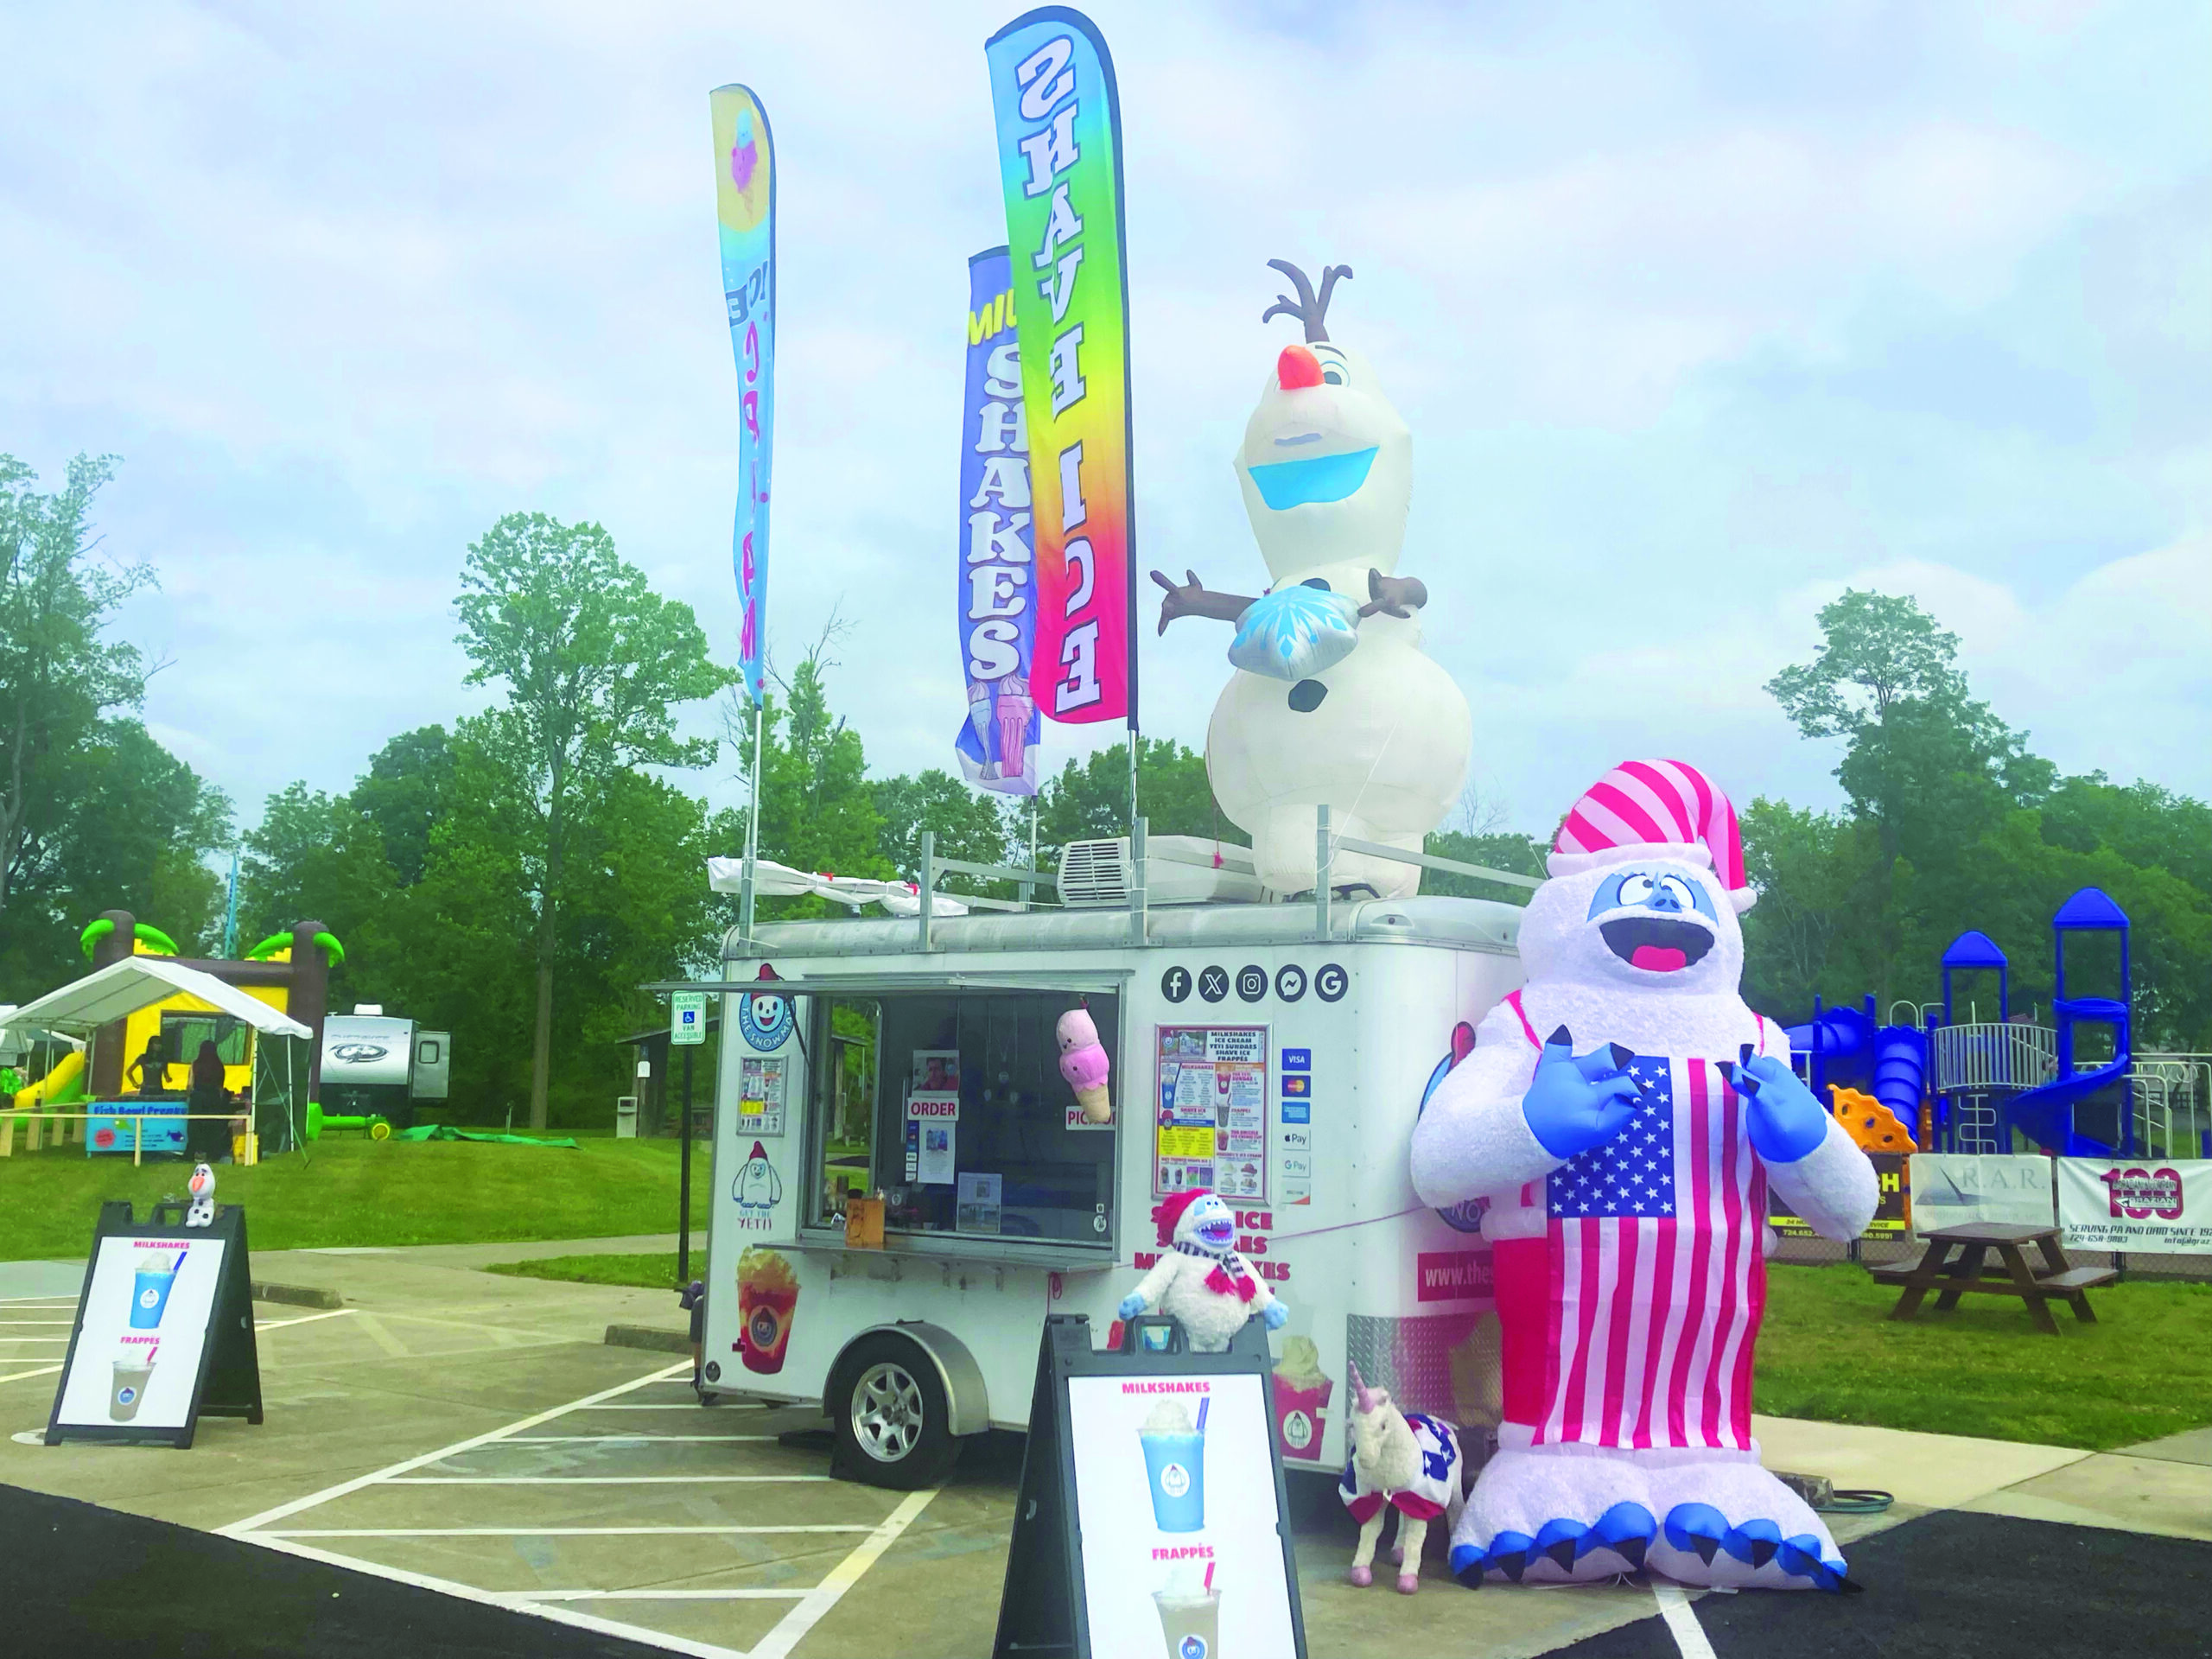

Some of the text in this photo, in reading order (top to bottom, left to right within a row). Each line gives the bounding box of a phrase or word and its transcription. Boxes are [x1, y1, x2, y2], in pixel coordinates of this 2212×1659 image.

[966, 342, 1032, 683] SHAKES
[742, 1007, 752, 1033] THE
[911, 1102, 956, 1116] ORDER
[1292, 1134, 1306, 1145] Pay
[1294, 1161, 1306, 1171] Pay
[1962, 1168, 2045, 1189] R.A.R.
[1236, 1211, 1273, 1230] ICE
[2069, 1224, 2107, 1234] SERVING
[2110, 1225, 2123, 1234] PA
[2126, 1225, 2144, 1235] AND
[2171, 1227, 2196, 1236] SINCE
[133, 1241, 190, 1249] MILKSHAKES
[1122, 1382, 1211, 1394] MILKSHAKES
